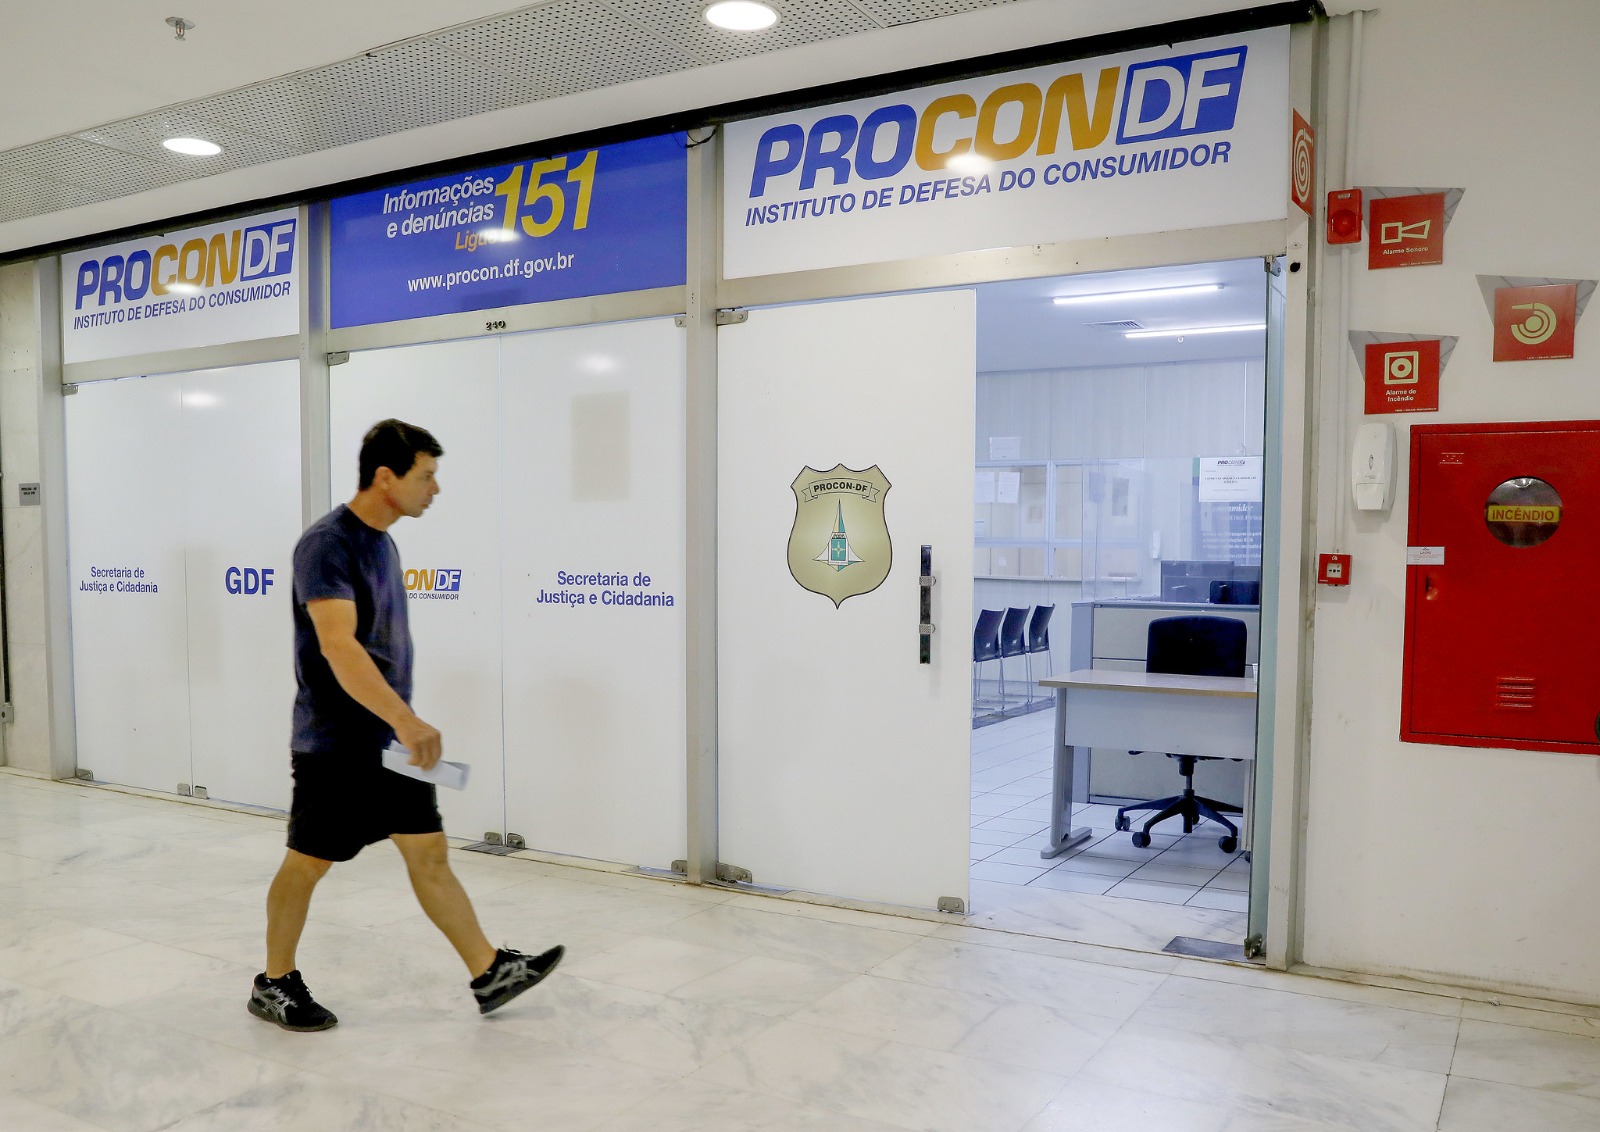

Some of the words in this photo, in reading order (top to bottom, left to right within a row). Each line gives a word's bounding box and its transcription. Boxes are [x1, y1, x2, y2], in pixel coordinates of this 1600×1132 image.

[745, 193, 856, 227] INSTITUTO
[862, 186, 894, 211] DE
[899, 174, 992, 206] DEFESA
[998, 167, 1036, 192] DO
[1044, 141, 1231, 186] CONSUMIDOR
[383, 175, 494, 216] Informações
[495, 150, 599, 241] 151
[386, 222, 398, 239] e
[401, 201, 494, 237] denúncias
[1383, 248, 1405, 256] Alarme
[407, 252, 575, 292] www.procon.df.gov.br
[73, 309, 125, 330] INSTITUTO
[127, 306, 142, 322] DE
[144, 298, 186, 319] DEFESA
[189, 295, 206, 311] DO
[209, 280, 291, 309] CONSUMIDOR
[485, 319, 507, 331] 240
[813, 481, 868, 493] PROCON-DF
[1491, 507, 1555, 522] INCÊNDIO
[90, 566, 132, 579] Secretaria
[133, 567, 145, 579] de
[225, 566, 274, 596] GDF
[557, 570, 629, 587] Secretaria
[633, 572, 651, 588] de
[79, 580, 108, 595] Justiça
[109, 584, 115, 593] e
[116, 581, 158, 594] Cidadania
[418, 592, 459, 601] CONSUMIDOR
[536, 589, 585, 608] Justiça
[588, 593, 598, 605] e
[601, 590, 675, 607] Cidadania
